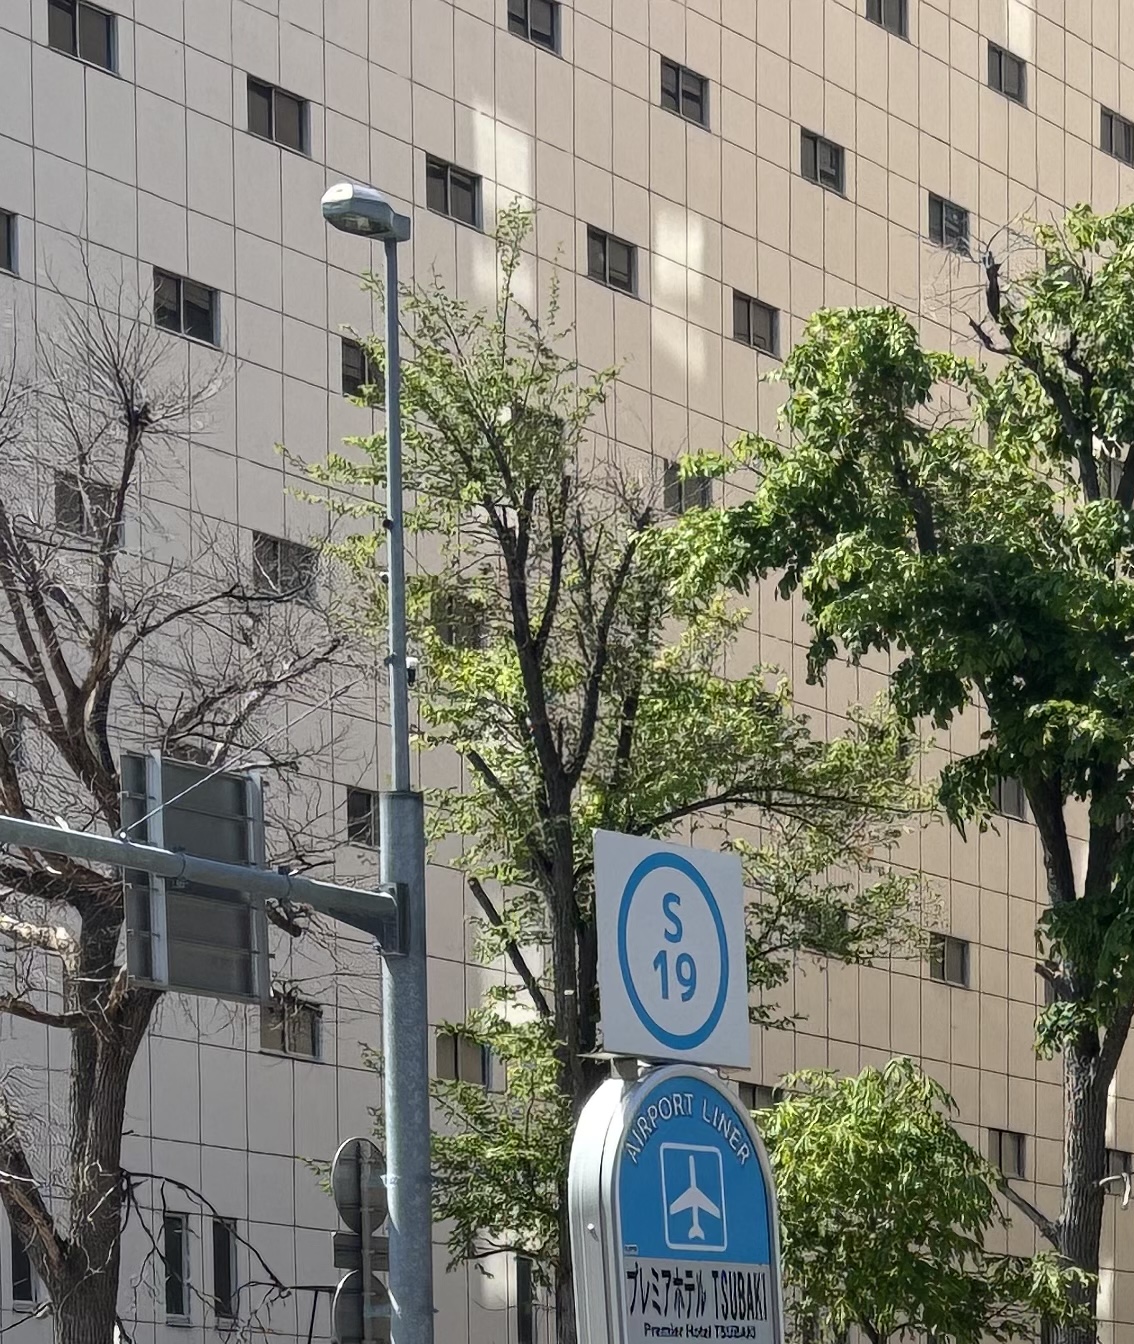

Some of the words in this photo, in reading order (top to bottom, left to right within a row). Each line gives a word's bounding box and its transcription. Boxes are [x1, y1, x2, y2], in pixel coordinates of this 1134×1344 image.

[662, 892, 683, 943] S
[653, 950, 697, 1002] 19
[625, 1093, 694, 1164] AIRPORT
[702, 1098, 750, 1165] LINER
[626, 1261, 707, 1319] プレミアホテル
[711, 1269, 768, 1321] TSUBAKI
[686, 1323, 711, 1339] Hotel
